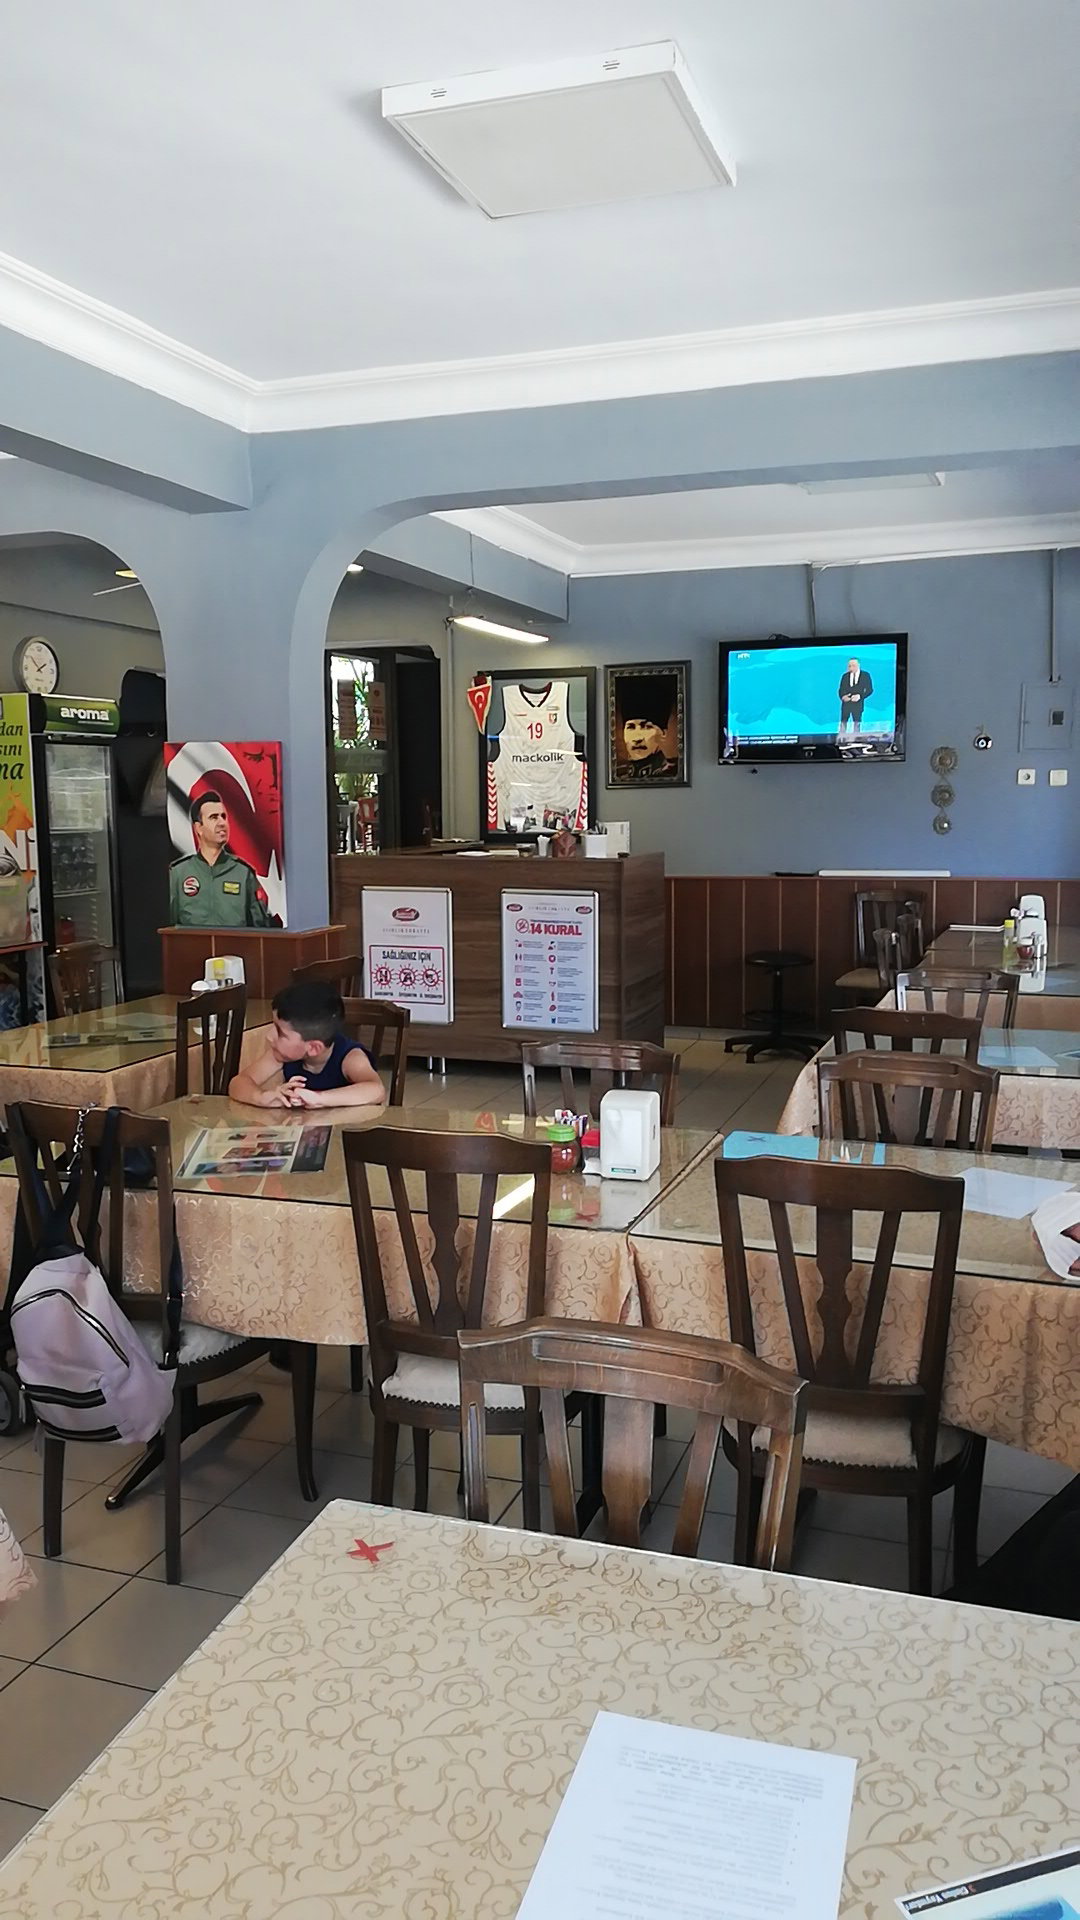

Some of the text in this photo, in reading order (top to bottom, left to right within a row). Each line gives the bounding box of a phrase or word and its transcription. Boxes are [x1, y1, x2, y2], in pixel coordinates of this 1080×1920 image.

[60, 707, 109, 721] aroma
[527, 722, 543, 740] 19
[512, 753, 564, 763] mackolik
[530, 923, 582, 936] 14 KURAL
